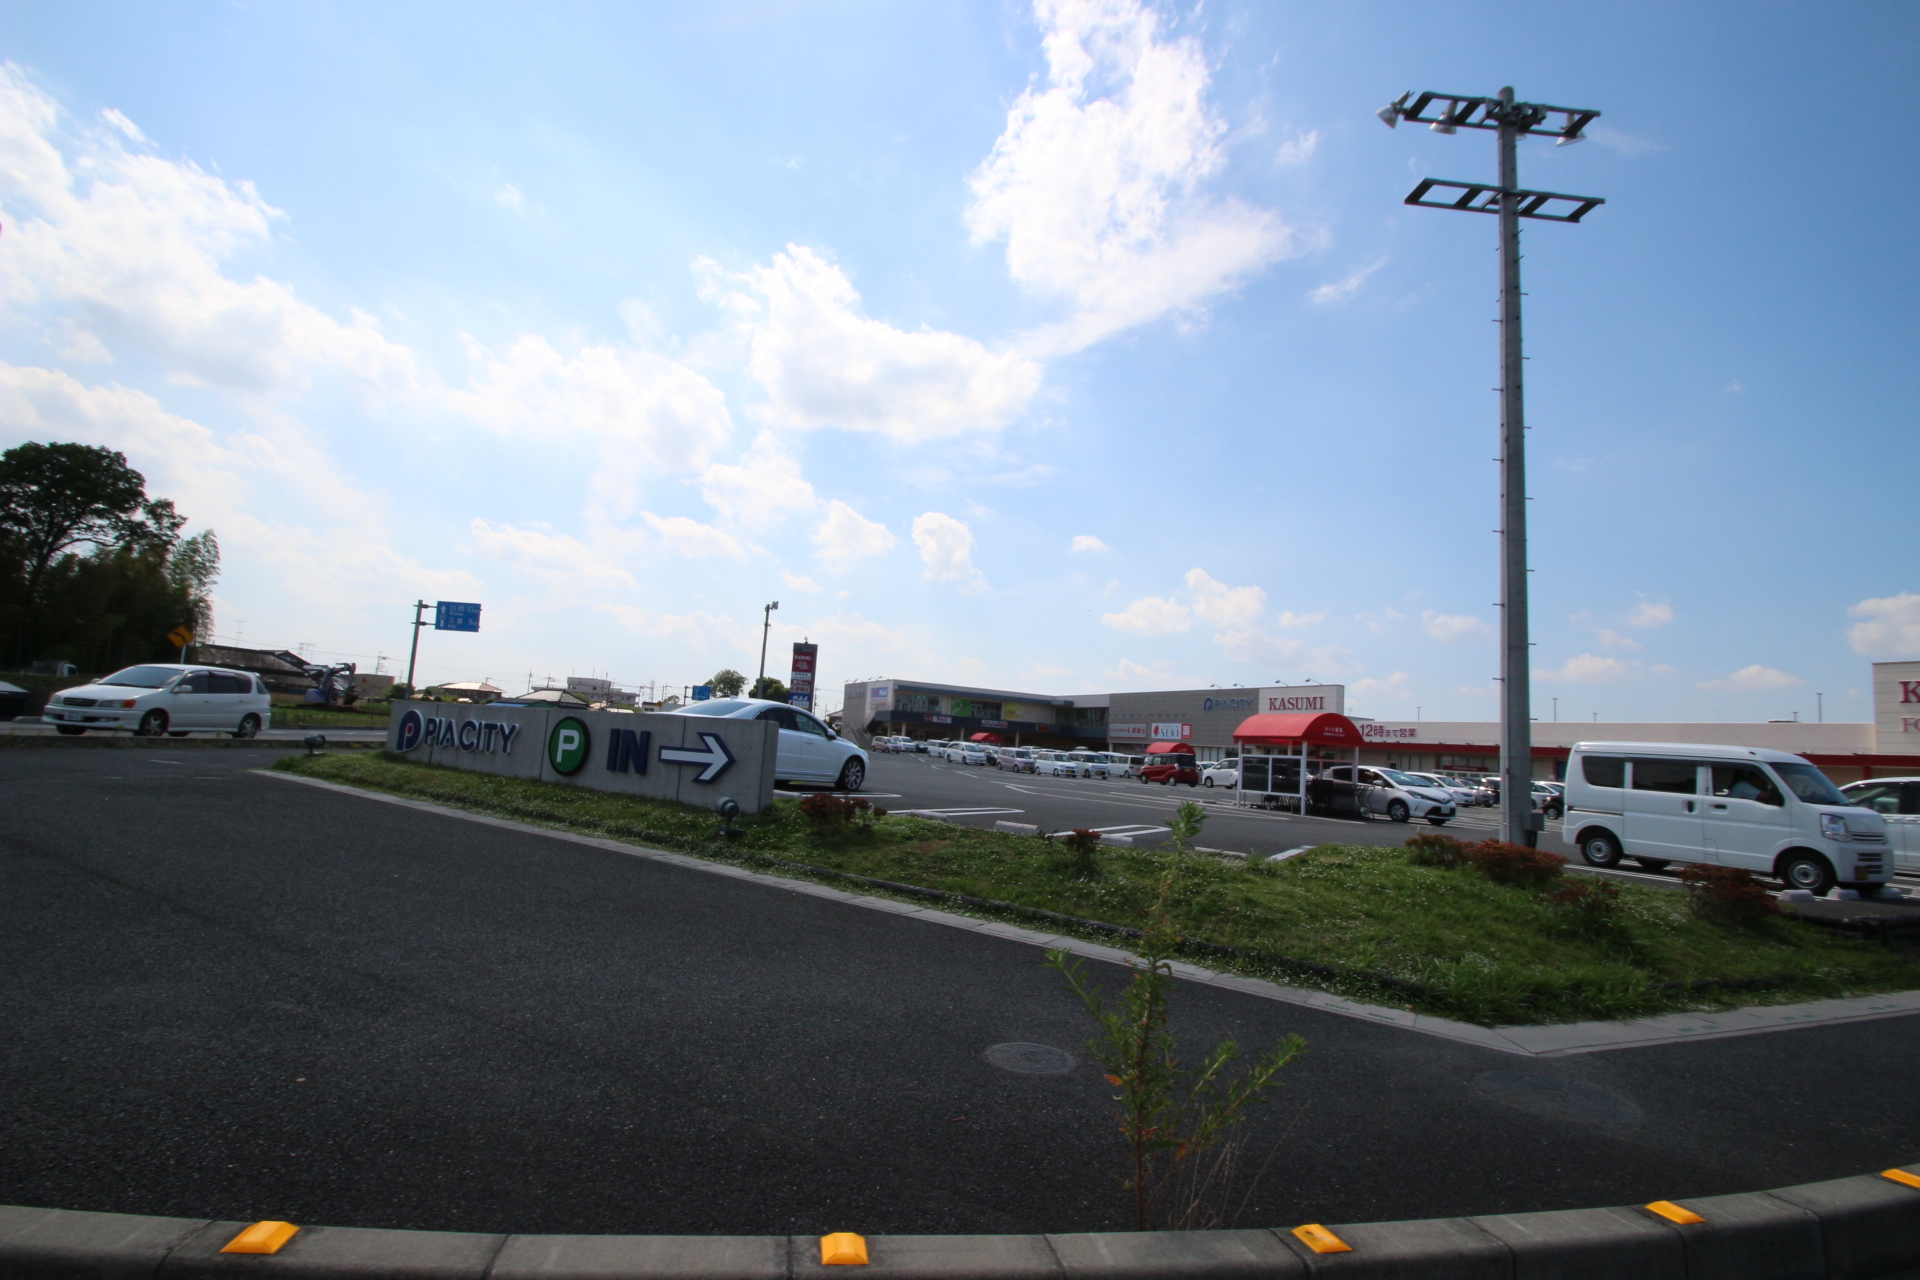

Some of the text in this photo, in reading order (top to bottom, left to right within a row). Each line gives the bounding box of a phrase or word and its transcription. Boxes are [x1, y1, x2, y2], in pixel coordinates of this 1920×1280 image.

[1268, 696, 1325, 711] KASUMI
[424, 717, 520, 755] PIACITY
[556, 728, 580, 763] P
[1160, 728, 1179, 737] SEKI
[606, 728, 652, 776] IN
